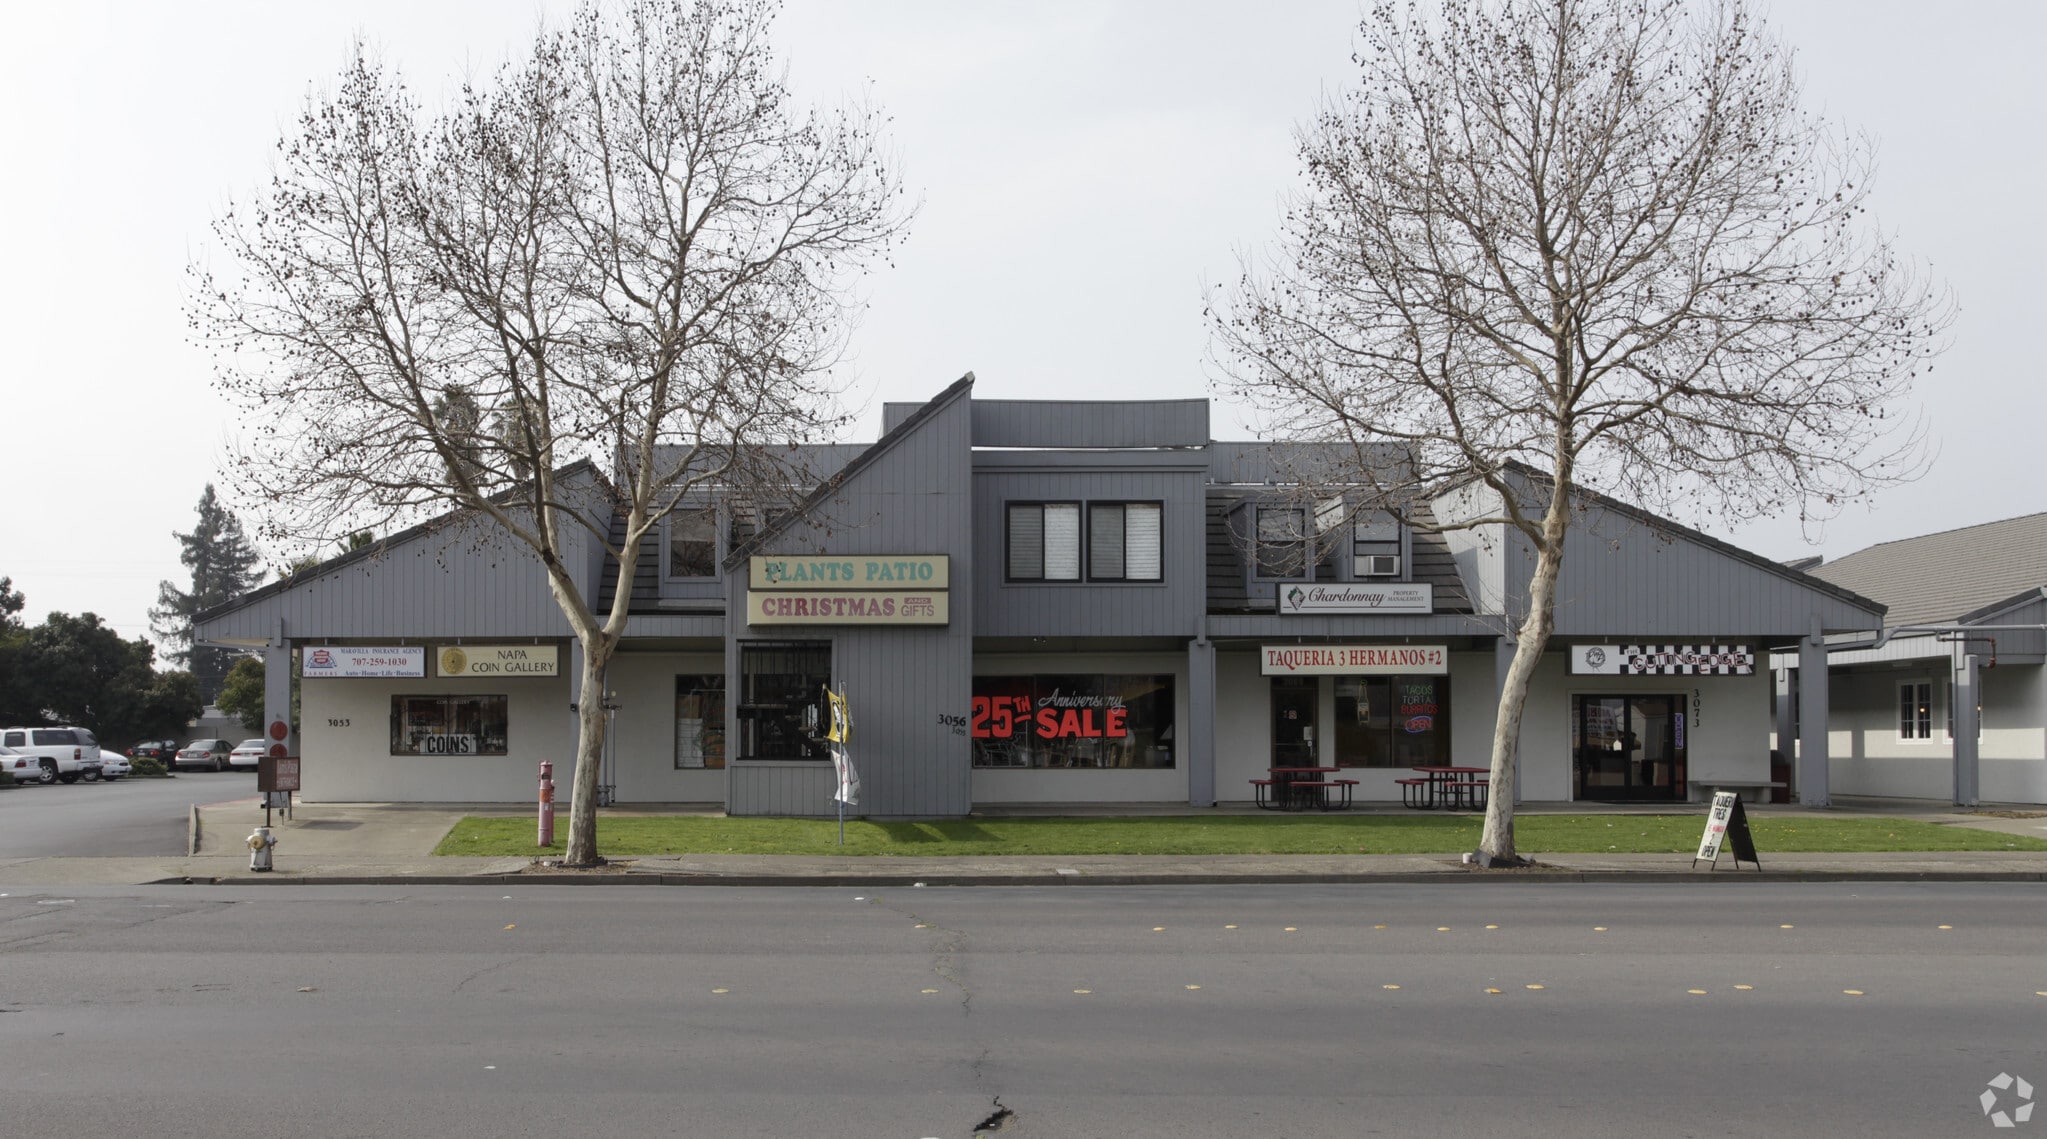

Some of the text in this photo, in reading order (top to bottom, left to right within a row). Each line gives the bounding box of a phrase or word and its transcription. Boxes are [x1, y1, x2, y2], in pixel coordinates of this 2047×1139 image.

[765, 562, 933, 582] PLANTS PATIO
[1308, 587, 1385, 608] Chardonnay
[761, 598, 934, 617] CHRISTMAS GIFTS
[351, 657, 408, 666] 707-259-1030
[497, 650, 528, 660] NAPA
[1268, 650, 1442, 670] TAQUERIA 3 HERMANOS #2
[1632, 651, 1750, 673] CUTTING EDGE
[471, 662, 555, 673] COIN GALLERY
[1405, 684, 1433, 695] TACOS
[1400, 704, 1439, 715] BURRITOS
[327, 718, 350, 727] 3053
[937, 713, 967, 727] 3056
[1036, 707, 1128, 739] SALE
[1405, 718, 1433, 730] OPEN
[427, 736, 469, 753] COINS
